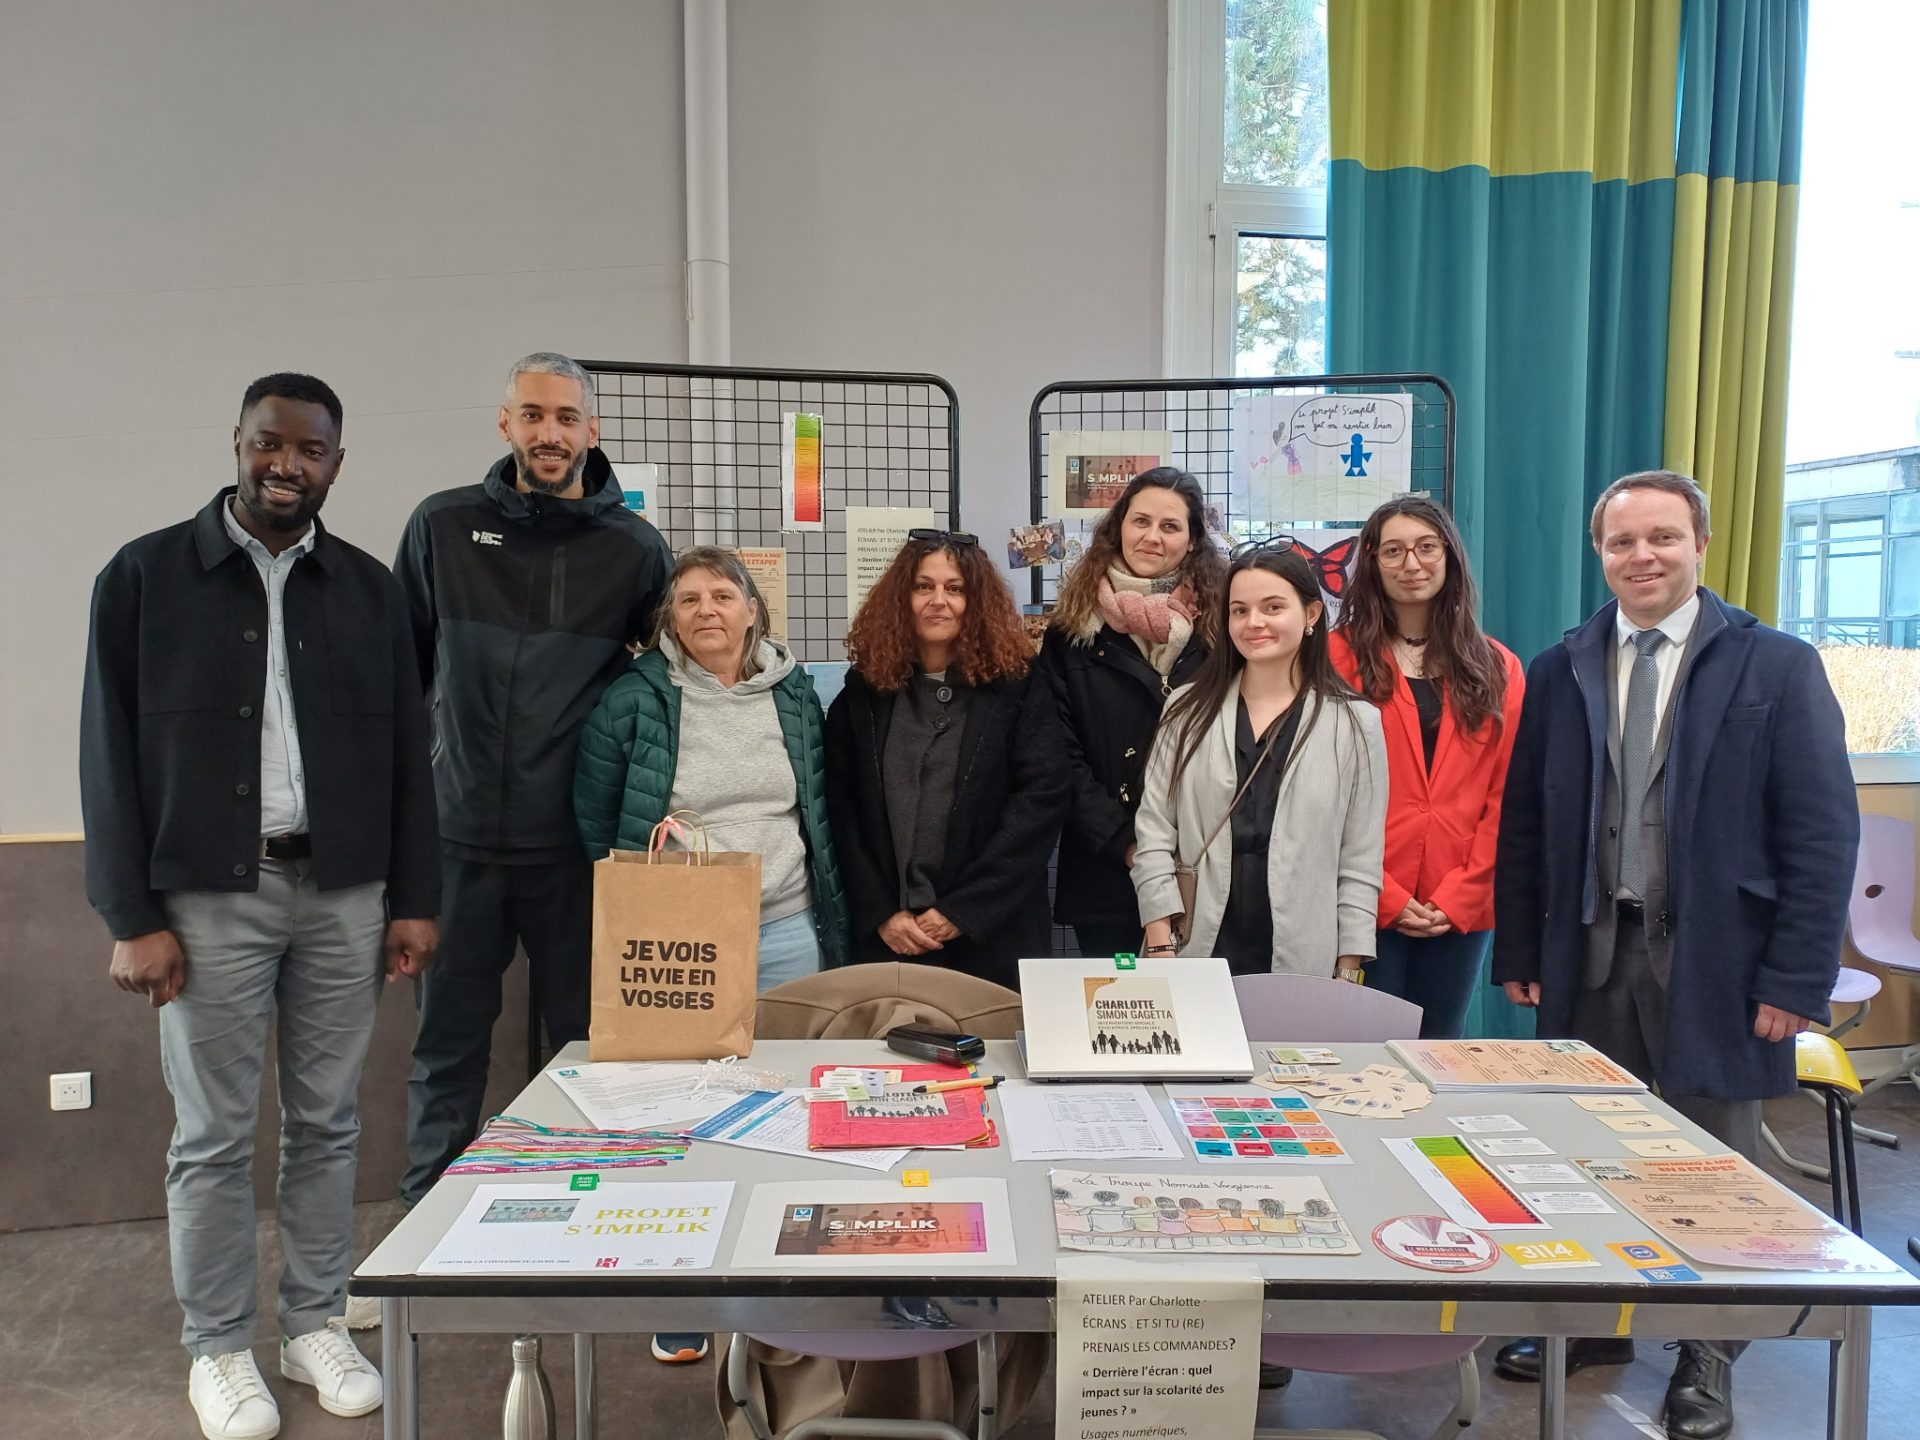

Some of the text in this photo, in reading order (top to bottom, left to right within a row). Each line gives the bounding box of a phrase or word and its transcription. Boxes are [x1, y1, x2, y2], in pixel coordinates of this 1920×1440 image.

[1373, 417, 1392, 429] bien
[622, 940, 717, 963] JE VOIS
[621, 966, 647, 984] LA
[650, 968, 684, 985] VIE
[621, 989, 715, 1010] VOSGES
[1095, 1000, 1155, 1010] CHARLOTTE
[1097, 1010, 1174, 1020] SIMON GAGETTA
[1072, 1174, 1274, 1192] La Troupe Nomade Vosgienne
[595, 1206, 718, 1220] PROJET
[564, 1222, 712, 1236] S'IMPLIK
[1516, 1243, 1573, 1259] 3114
[1082, 1294, 1200, 1307] ATELIER Par Charlotte
[1082, 1315, 1127, 1329] ÉCRANS
[1136, 1319, 1148, 1329] ET
[1152, 1319, 1161, 1329] SI
[1165, 1318, 1180, 1329] TU
[1183, 1318, 1204, 1330] (RE)
[1082, 1342, 1129, 1353] PRENAIS
[1133, 1341, 1150, 1352] LES
[1093, 1366, 1139, 1378] Derrière
[1142, 1366, 1179, 1377] l'écran
[1188, 1364, 1212, 1377] quel
[1082, 1384, 1225, 1400] impact sur la scolarité des
[1081, 1407, 1118, 1420] jeunes
[1121, 1405, 1127, 1416] ?
[1081, 1426, 1188, 1440] Usages numériques,
